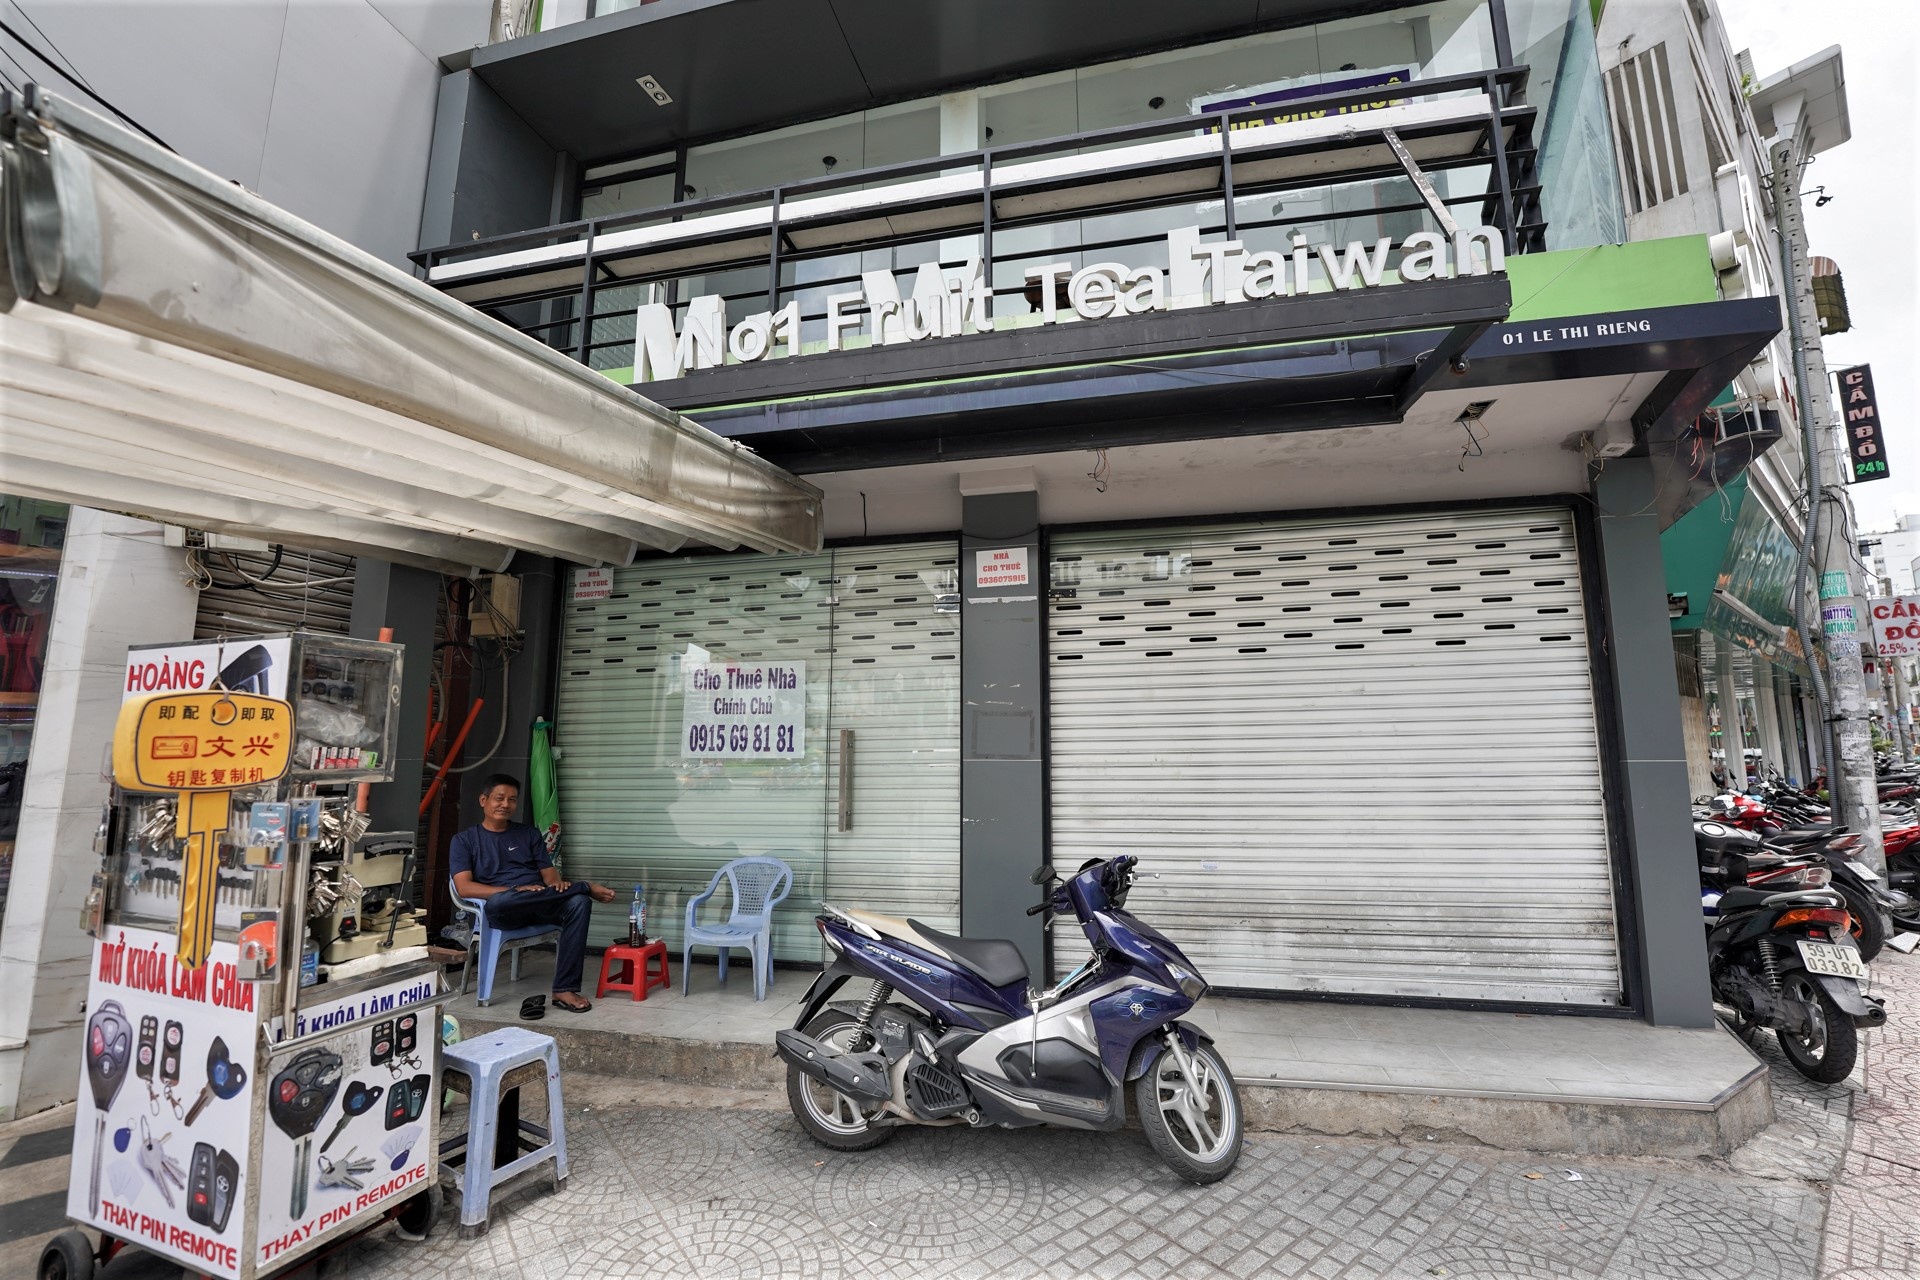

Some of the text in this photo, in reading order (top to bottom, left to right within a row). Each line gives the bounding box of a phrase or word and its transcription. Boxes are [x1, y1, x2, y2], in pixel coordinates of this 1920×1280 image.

[827, 275, 994, 351] Fruit
[1025, 261, 1167, 325] Tea
[1191, 225, 1507, 305] Taiwan
[1502, 319, 1651, 345] 01 LE THI RIENG
[1856, 460, 1886, 475] 24h
[983, 561, 1021, 573] CHO THUÊ
[978, 574, 1026, 585] 0936075915
[127, 655, 205, 692] HOÀNG
[693, 667, 797, 690] Cho Thuê Nhà
[159, 705, 275, 721] 即配 即取
[714, 695, 773, 715] Chính Chủ
[201, 735, 274, 758] 文兴
[689, 724, 795, 752] 0915 69 81 81
[167, 767, 265, 788] 钥匙复制机
[98, 931, 126, 986] MỞ
[126, 942, 167, 995] KHÓA
[1806, 943, 1851, 961] 59-U1
[1807, 957, 1864, 976] 033.82
[261, 1163, 426, 1260] THAY PIN REMOTE
[102, 1200, 237, 1270] THAY PIN REMOTE
